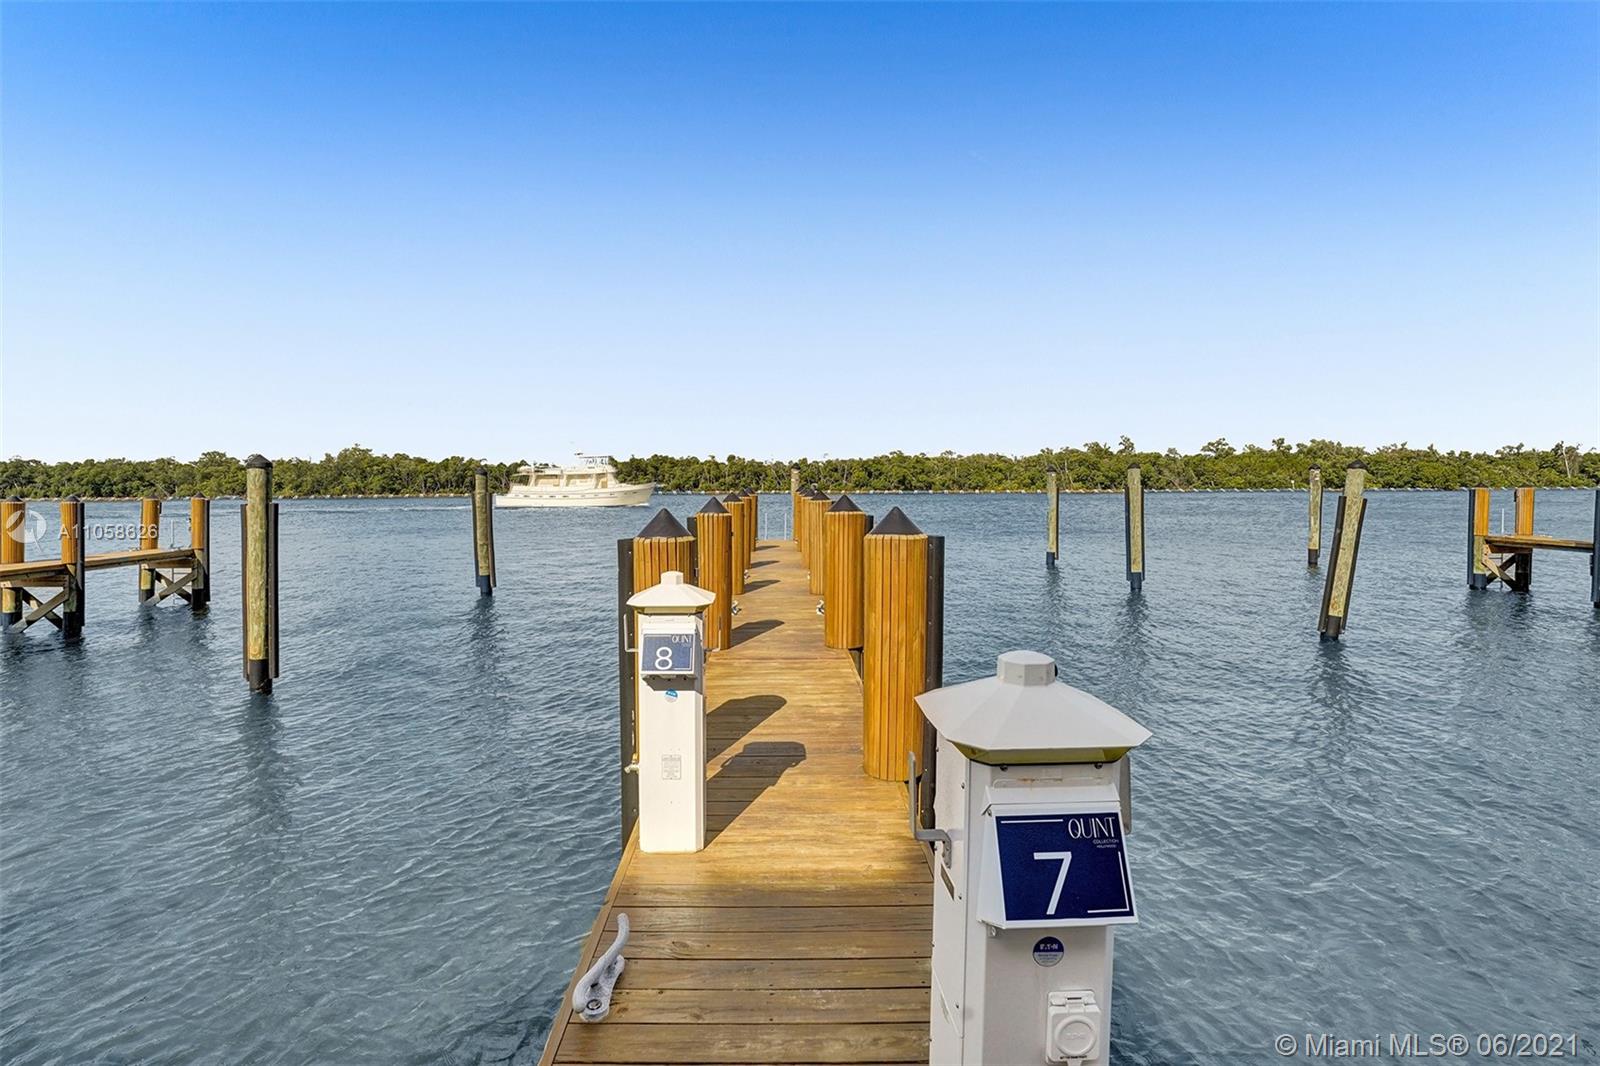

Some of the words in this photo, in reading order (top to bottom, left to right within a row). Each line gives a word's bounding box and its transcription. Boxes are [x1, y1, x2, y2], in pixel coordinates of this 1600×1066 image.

[654, 646, 673, 671] 8
[1068, 817, 1116, 839] QUINT
[1033, 851, 1072, 915] 7
